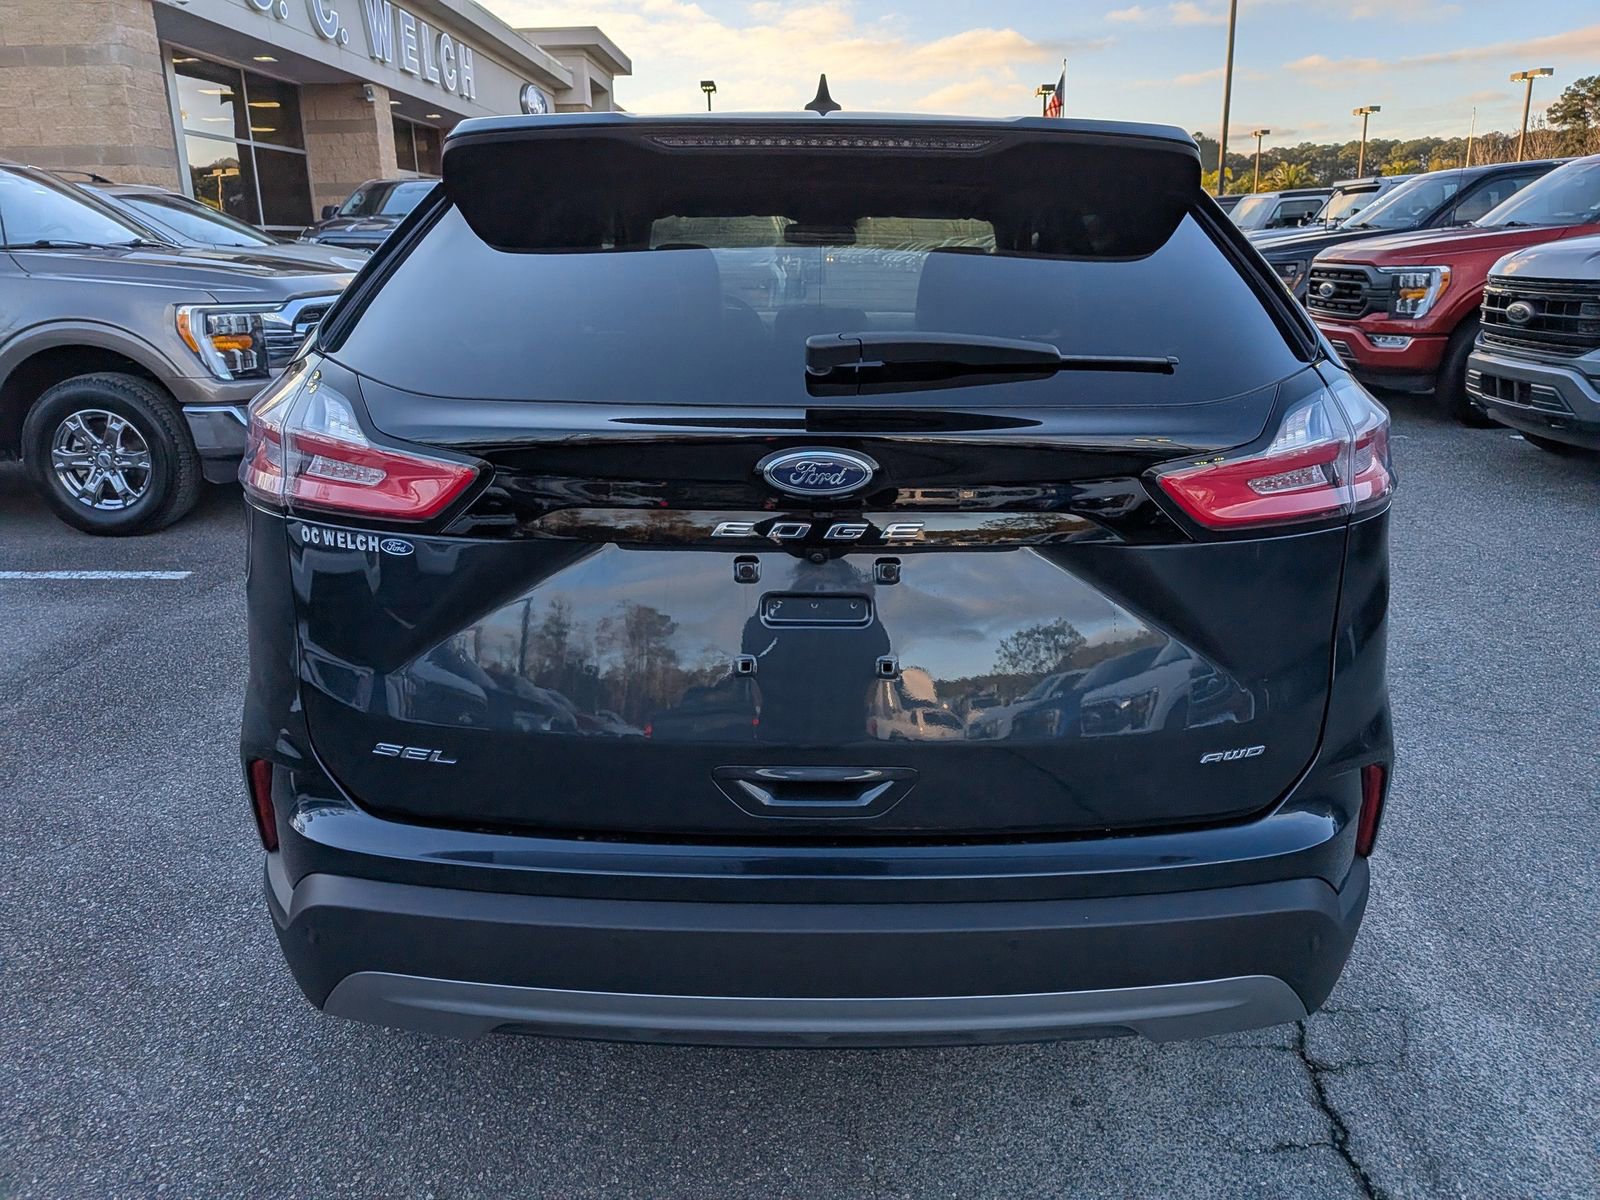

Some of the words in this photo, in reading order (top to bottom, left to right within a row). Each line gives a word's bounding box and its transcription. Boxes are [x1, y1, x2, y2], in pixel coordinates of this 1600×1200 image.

[363, 0, 476, 100] WELCH
[789, 461, 849, 486] Ford
[301, 525, 320, 544] OC
[323, 528, 380, 553] WELCH
[711, 521, 925, 539] EDGE
[372, 742, 457, 764] SEL
[1200, 745, 1266, 764] AWD
